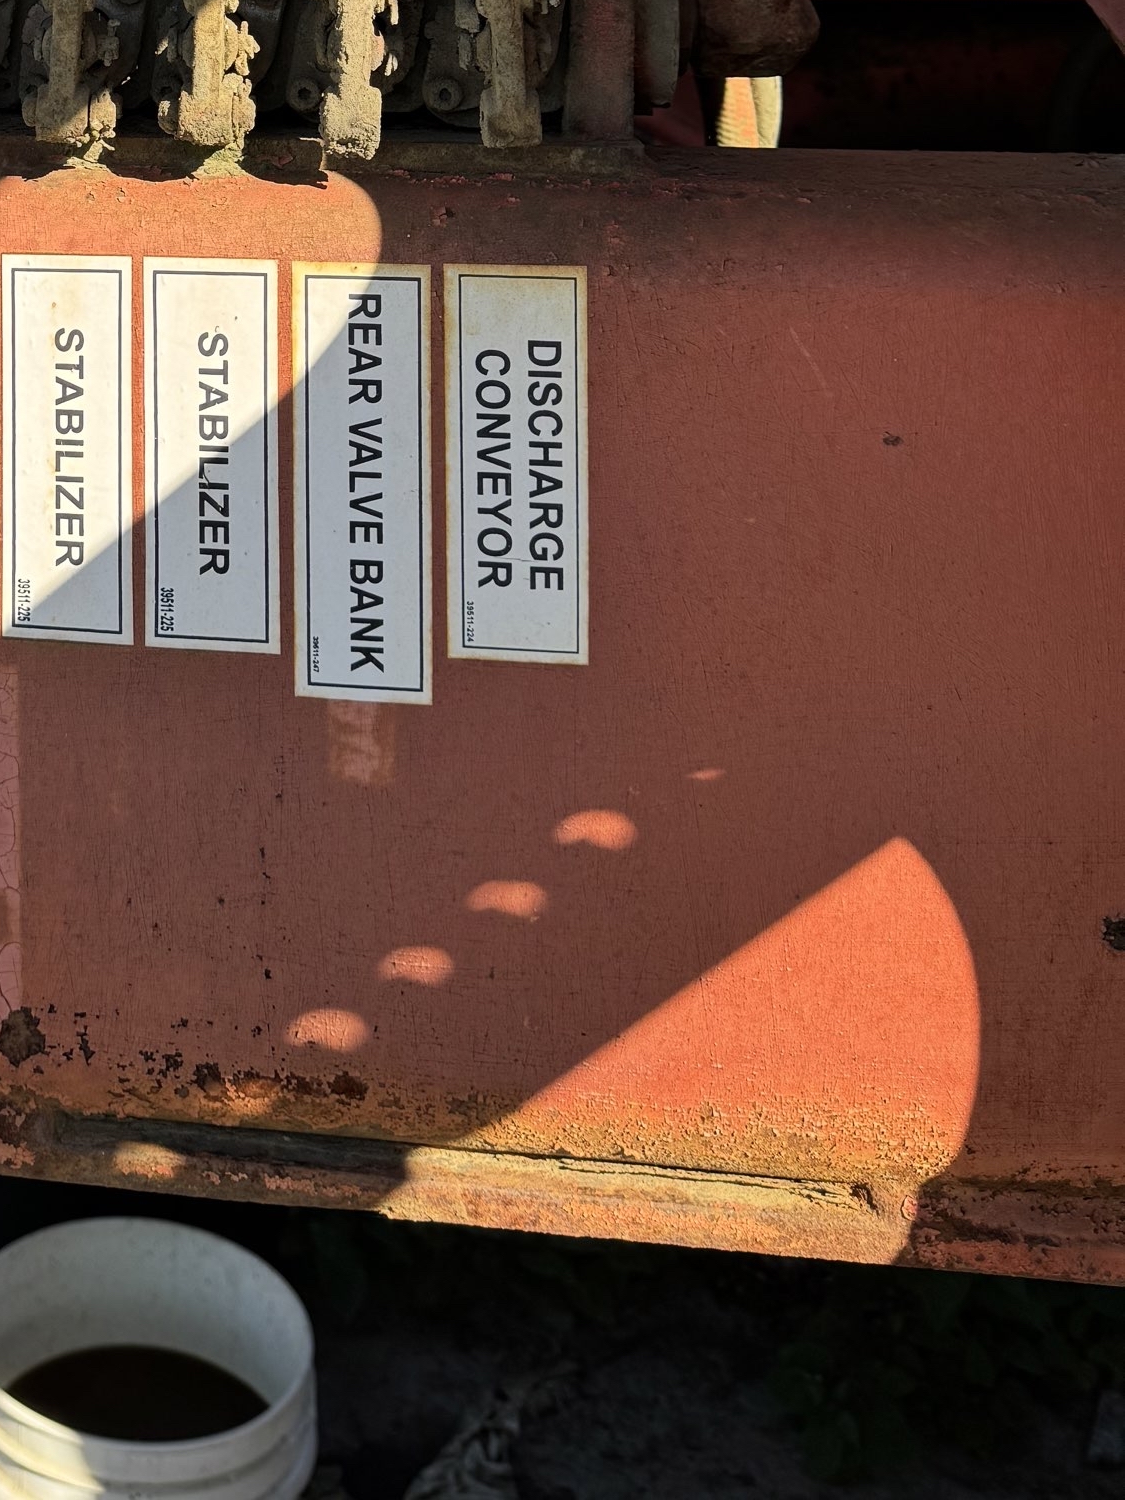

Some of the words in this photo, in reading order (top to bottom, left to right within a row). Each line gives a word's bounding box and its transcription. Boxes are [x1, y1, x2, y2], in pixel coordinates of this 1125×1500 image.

[348, 293, 383, 405] REAR
[54, 328, 86, 568] STABILIZER
[197, 331, 230, 577] STABILIZER
[348, 417, 384, 545] VALVE
[475, 349, 513, 589] CONVEYOR
[527, 339, 565, 591] DISCHARGE
[16, 578, 31, 623] 39511-225
[160, 587, 175, 633] 39511-225
[349, 558, 385, 674] BANK
